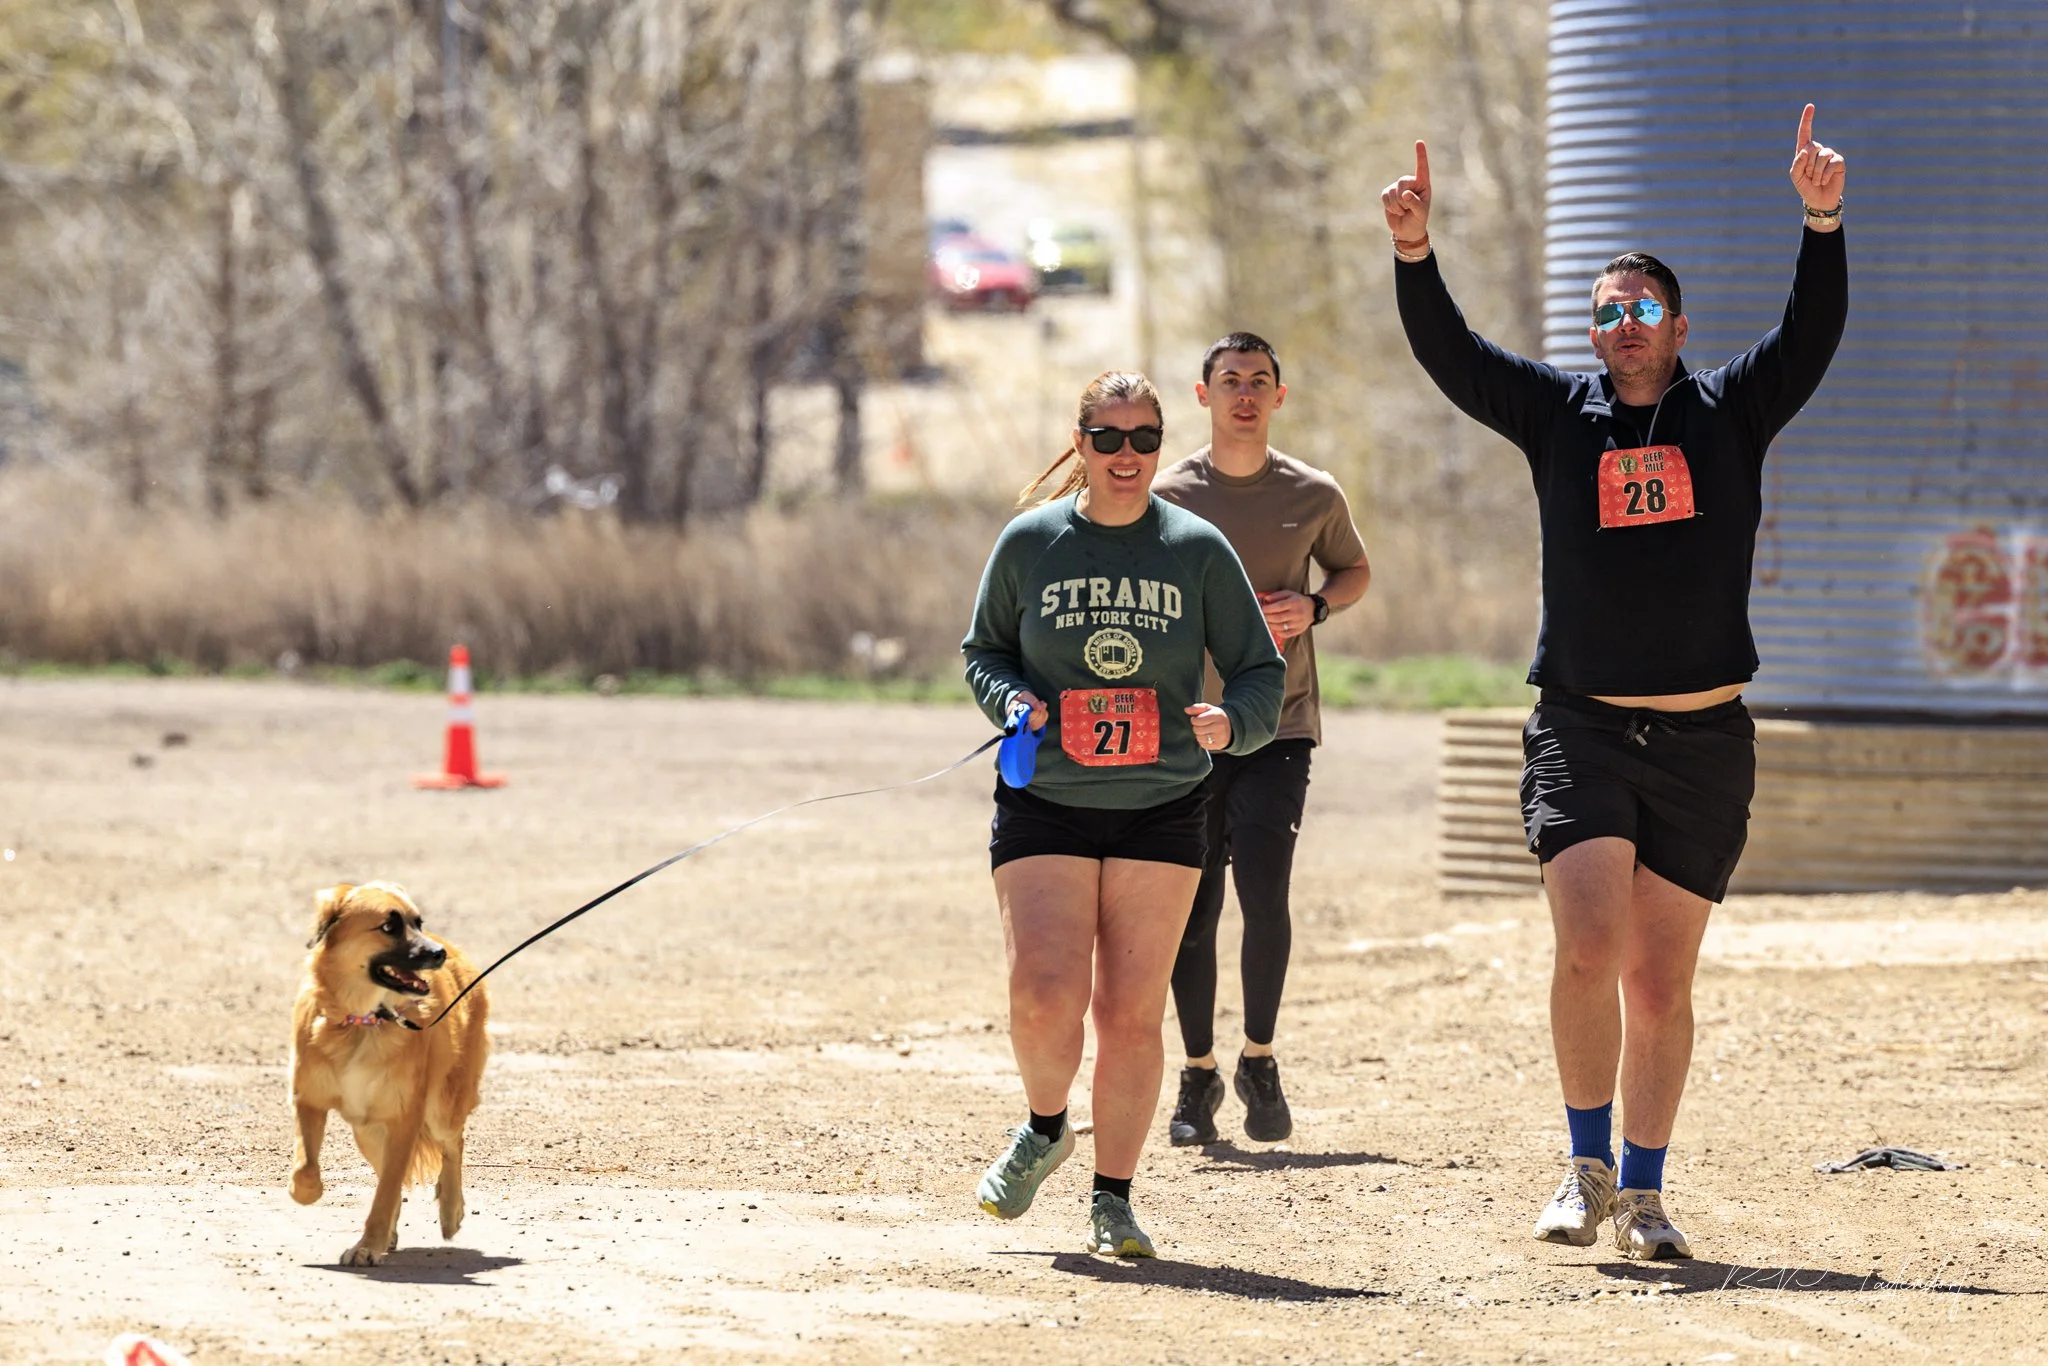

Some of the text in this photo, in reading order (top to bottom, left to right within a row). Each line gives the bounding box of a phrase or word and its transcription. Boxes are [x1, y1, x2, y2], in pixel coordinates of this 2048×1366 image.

[1643, 451, 1664, 462] BEER
[1645, 462, 1665, 473] MILE
[1623, 478, 1667, 516] 28
[1040, 576, 1183, 620] STRAND
[1055, 610, 1169, 633] NEW YORK CITY
[1093, 633, 1112, 646] MILES
[1123, 637, 1137, 657] BOOKS
[1114, 694, 1135, 703] BEER
[1115, 704, 1135, 714] MILE
[1093, 719, 1132, 756] 27
